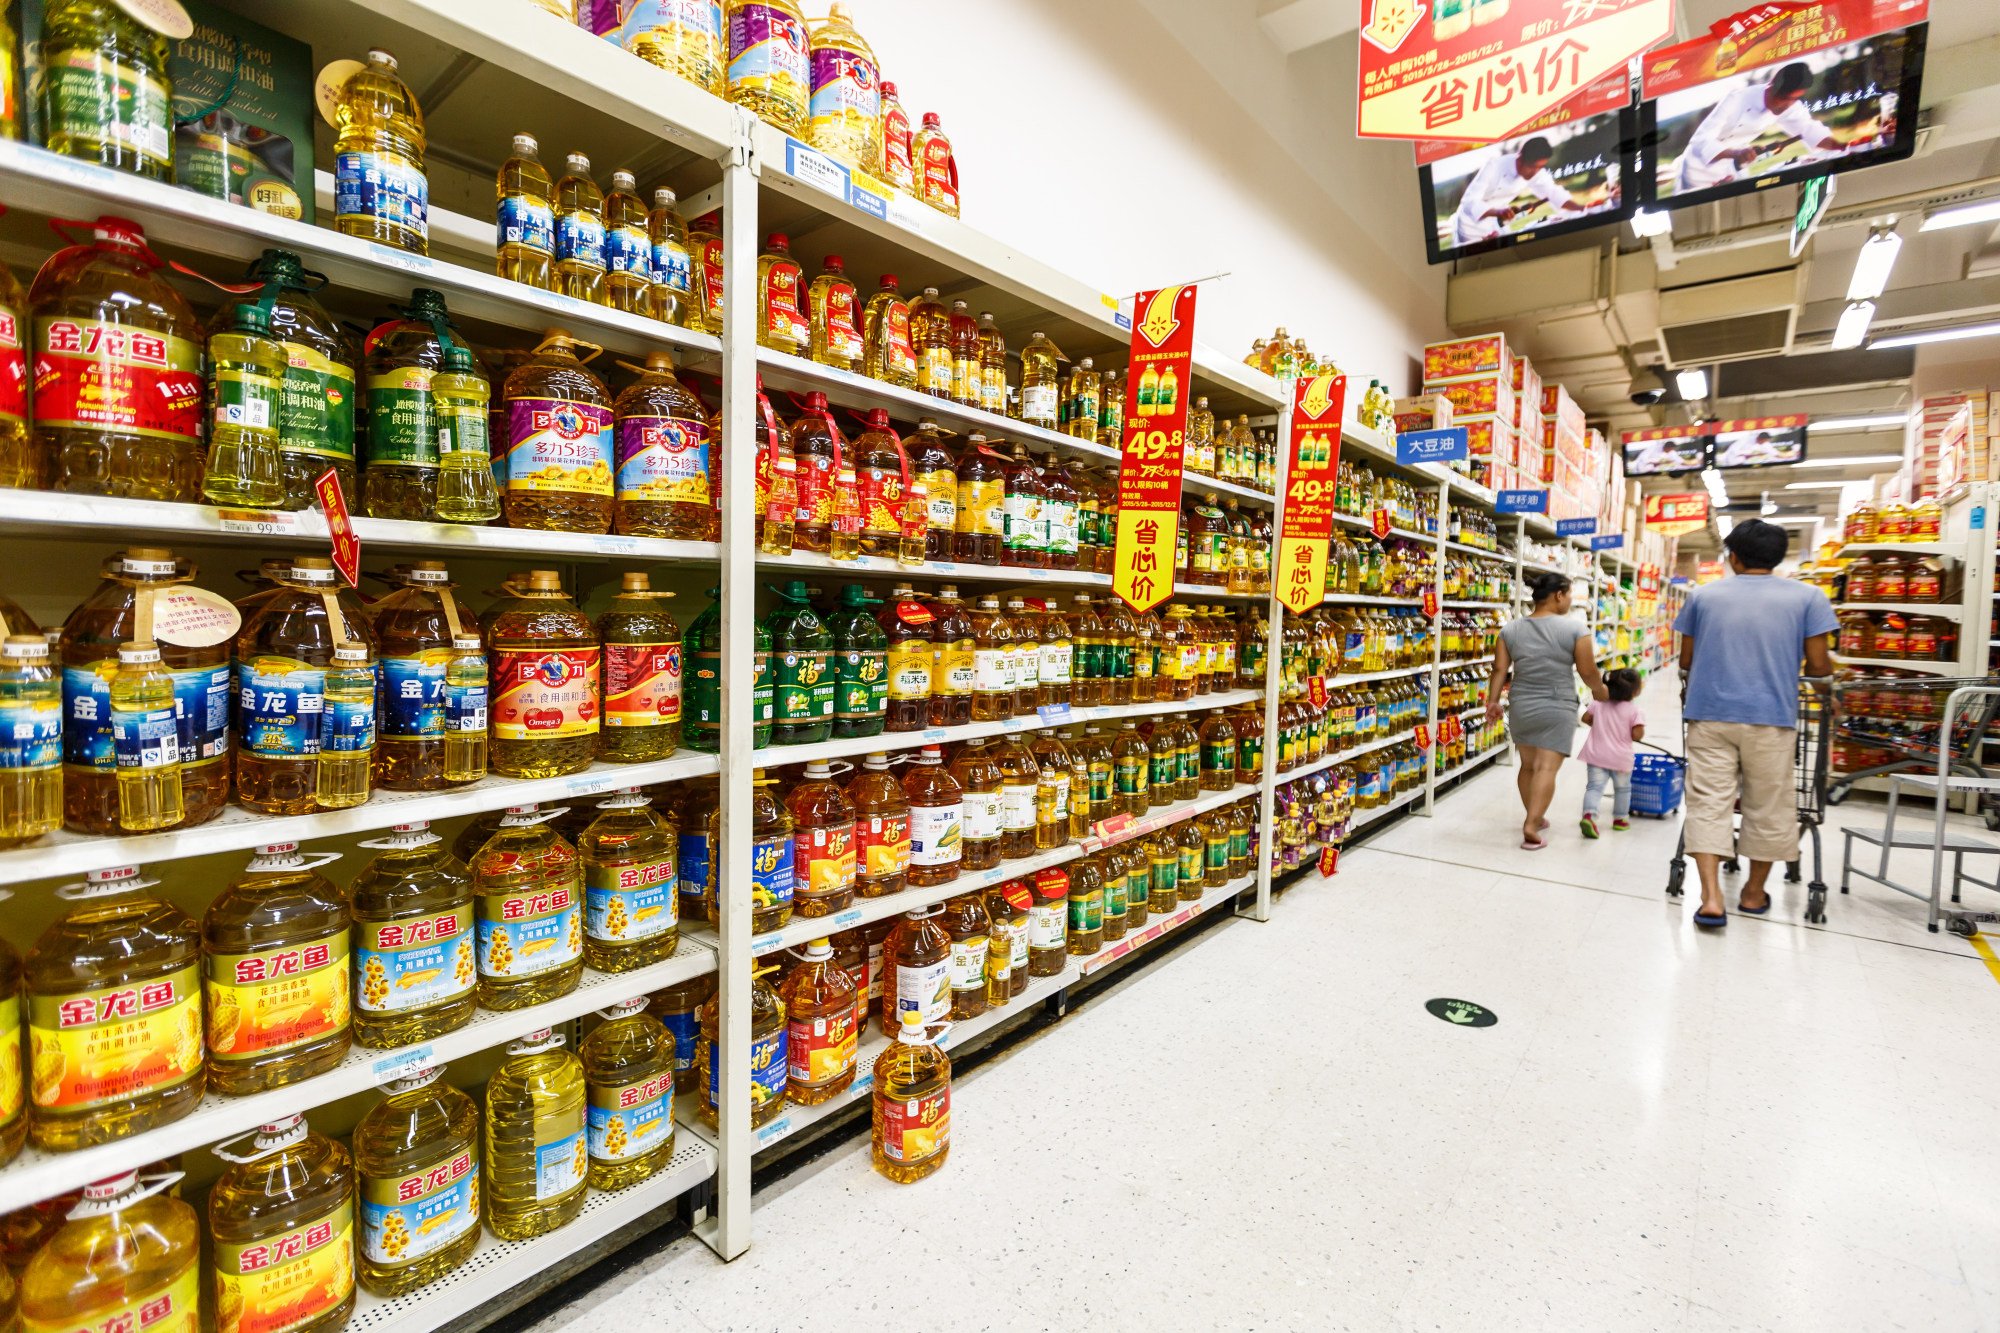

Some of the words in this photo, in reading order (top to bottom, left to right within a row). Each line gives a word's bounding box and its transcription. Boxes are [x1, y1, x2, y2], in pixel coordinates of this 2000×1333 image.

[1419, 38, 1590, 130] 省心价
[256, 189, 284, 205] 好礼
[48, 321, 168, 367] 金龙鱼
[156, 381, 198, 398] 1:1:1
[279, 392, 326, 412] 调和油
[391, 412, 437, 427] 食用调和
[537, 414, 549, 427] 多
[587, 420, 598, 432] 力
[534, 441, 600, 459] 多力5珍宝
[1126, 430, 1183, 460] 49.8
[1409, 437, 1455, 454] 大豆油
[645, 456, 700, 471] 多力5珍宝
[1288, 480, 1334, 502] 49.8
[1131, 519, 1159, 602] 省心价
[1290, 544, 1313, 605] 省心价
[522, 666, 536, 678] 多
[572, 665, 583, 676] 力
[241, 687, 324, 714] 金龙鱼
[540, 691, 587, 704] 食用调和油
[13, 722, 58, 739] 金龙
[620, 861, 673, 889] 金龙鱼
[503, 889, 570, 921] 金龙鱼
[378, 915, 459, 949] 金龙鱼
[518, 924, 560, 941] 食用调和油
[236, 944, 330, 984] 金龙鱼
[395, 955, 445, 972] 食用调和油
[60, 981, 175, 1028] 金龙鱼
[257, 988, 311, 1008] 食用调和油
[619, 1070, 673, 1108] 金龙鱼
[398, 1151, 471, 1203] 金龙鱼
[239, 1220, 333, 1274] 金龙鱼
